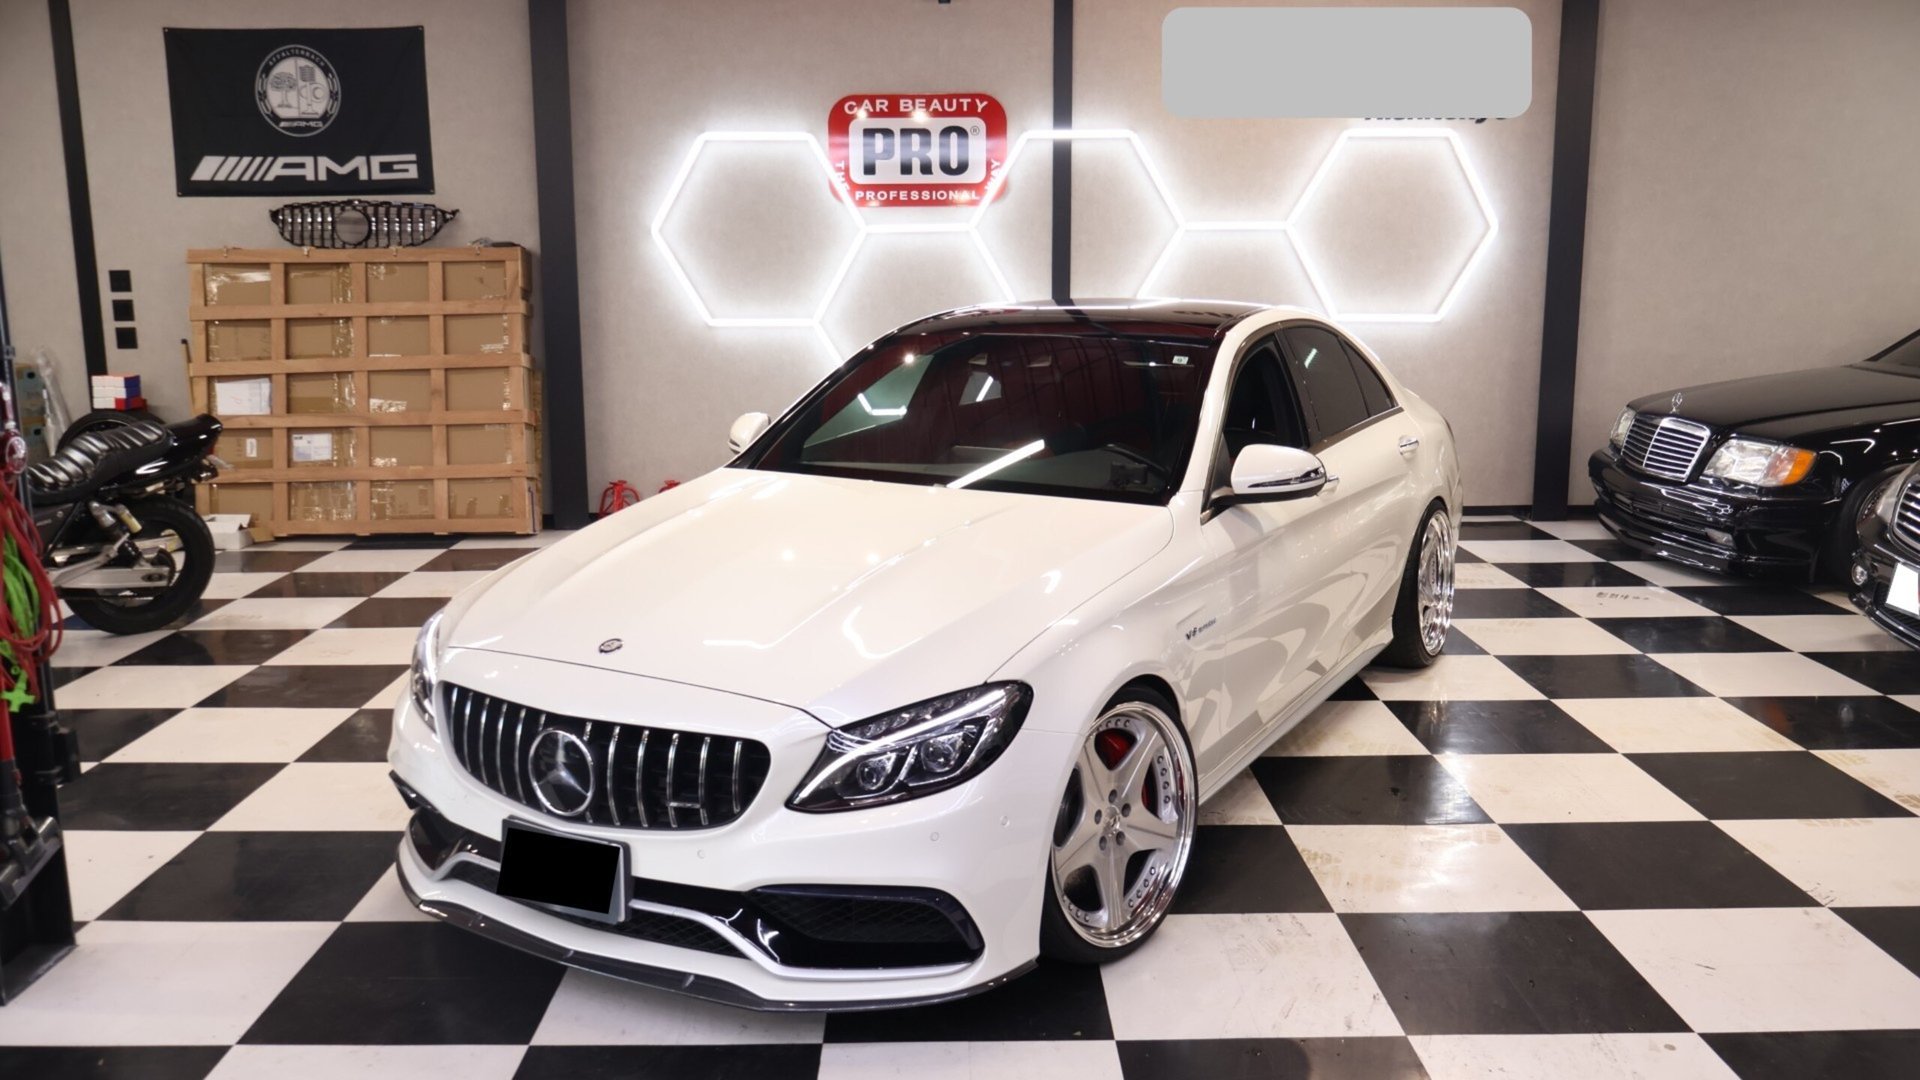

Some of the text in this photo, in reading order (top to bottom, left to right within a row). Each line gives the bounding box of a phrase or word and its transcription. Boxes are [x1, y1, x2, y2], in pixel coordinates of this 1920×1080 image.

[844, 97, 988, 115] CAR BEAUTY
[263, 154, 418, 181] AMG
[855, 189, 980, 201] PROFESSIONAL
